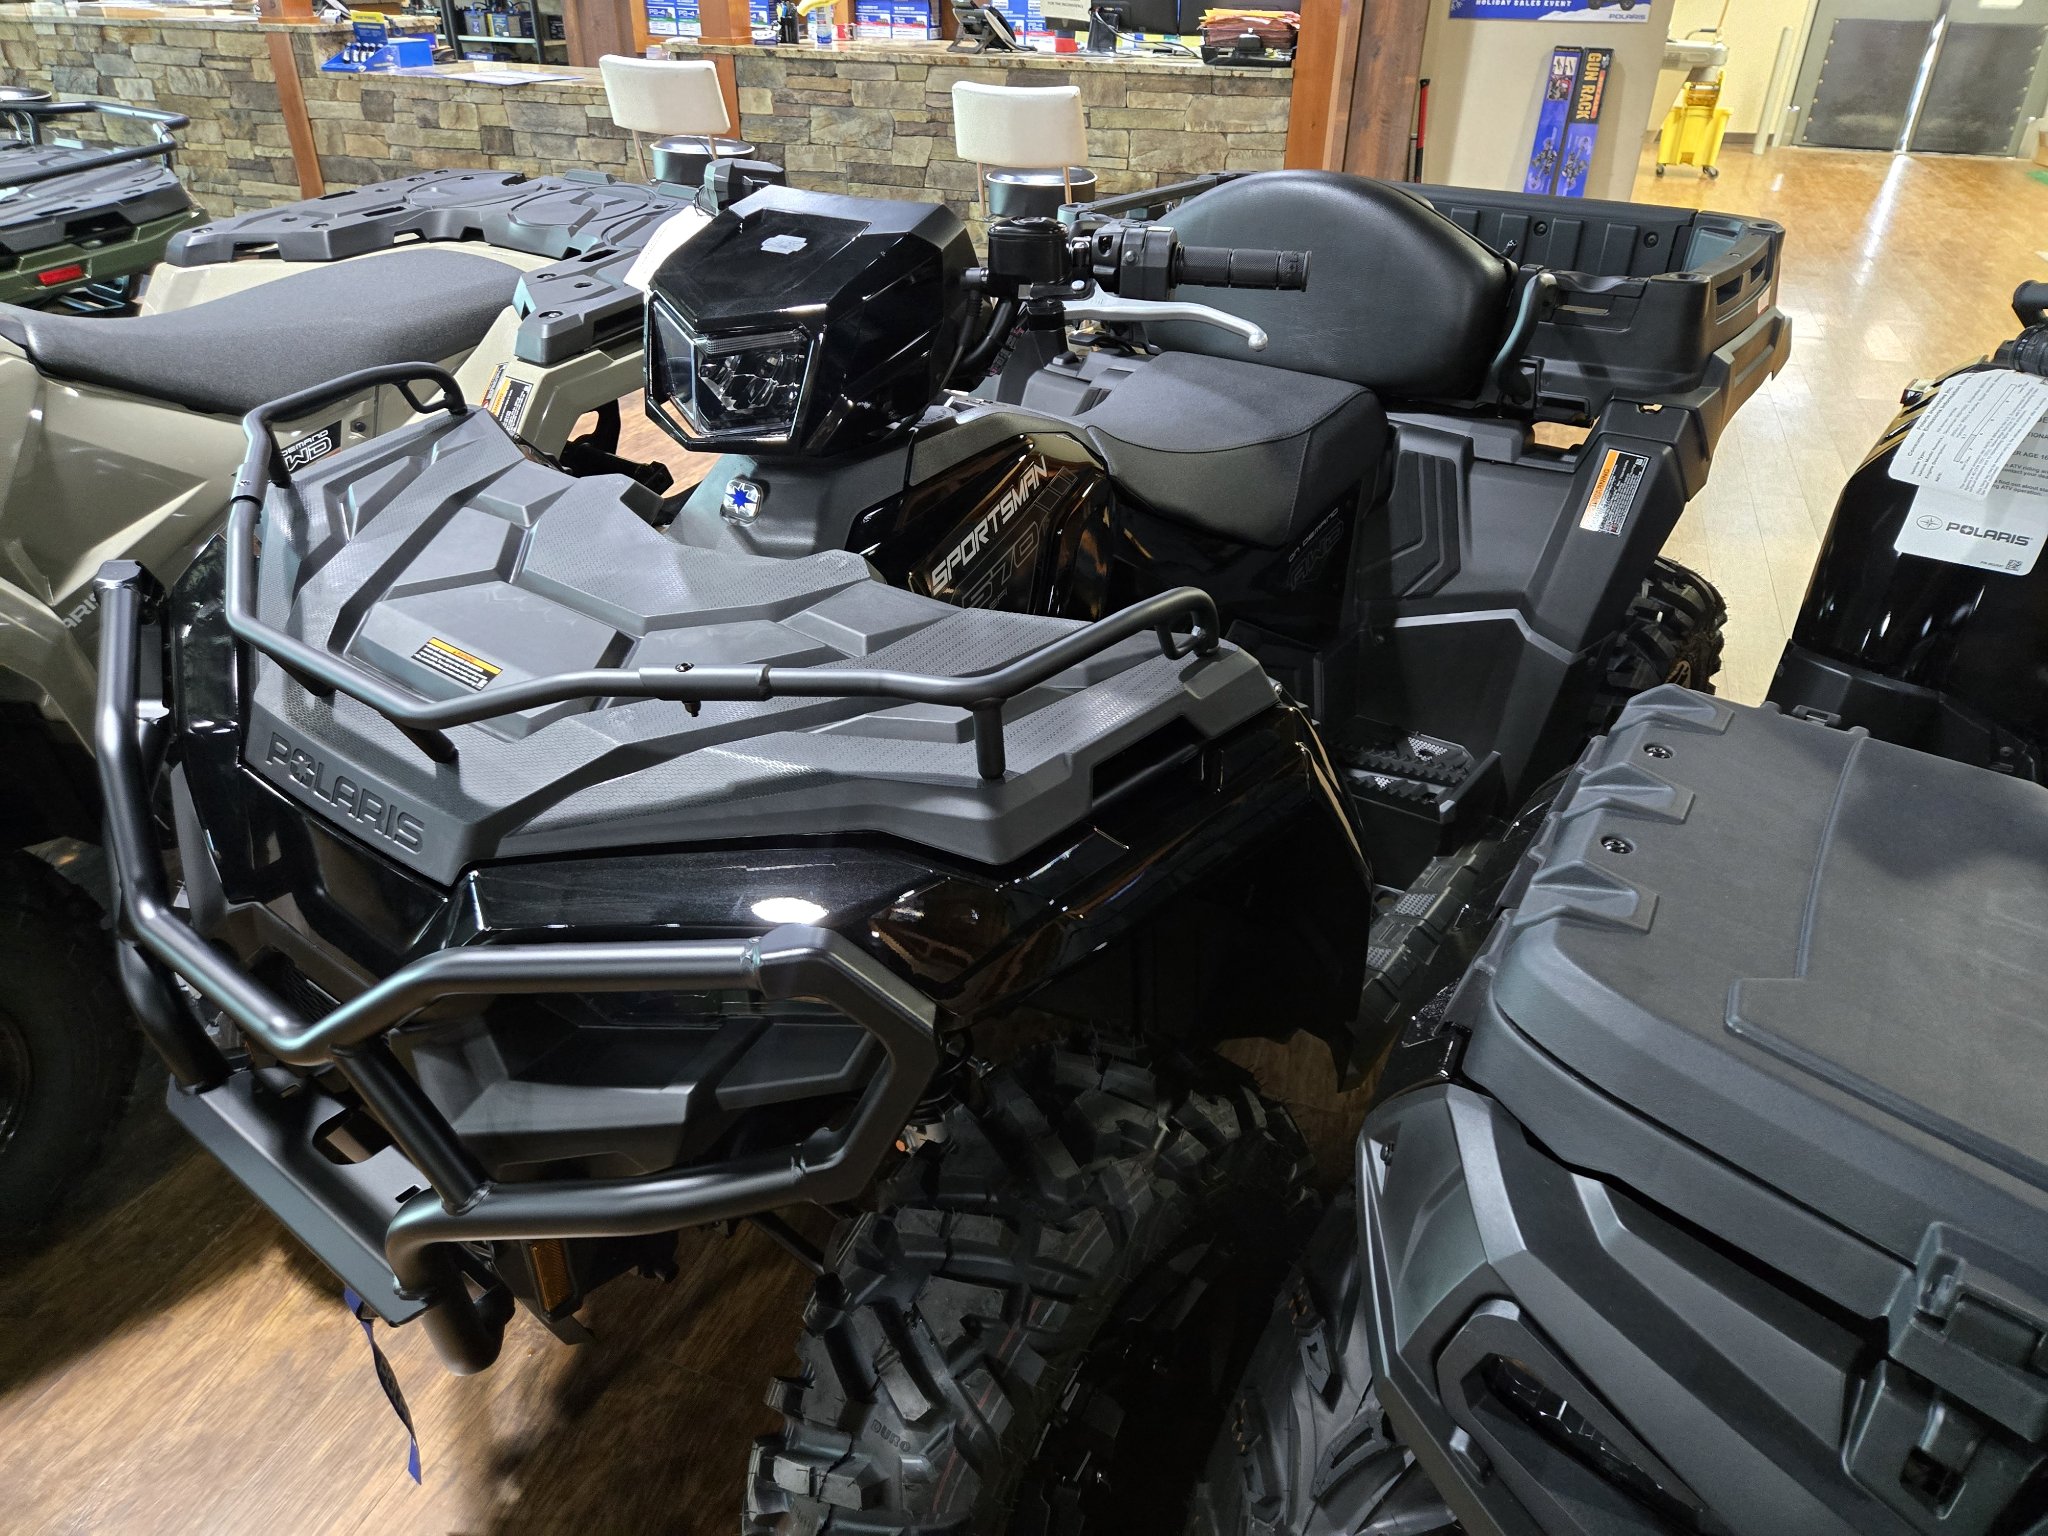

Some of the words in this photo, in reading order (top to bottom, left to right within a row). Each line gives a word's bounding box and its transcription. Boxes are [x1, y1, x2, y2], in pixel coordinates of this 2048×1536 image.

[1584, 52, 1602, 81] GUN
[1576, 84, 1597, 120] RACK
[285, 437, 332, 472] WD
[932, 455, 1048, 596] SPORTSMAN
[1302, 508, 1339, 547] DEMAND
[1946, 522, 2031, 547] POLARIS
[962, 521, 1039, 609] 570
[266, 732, 425, 855] POLARIS
[871, 1419, 911, 1453] DURO
